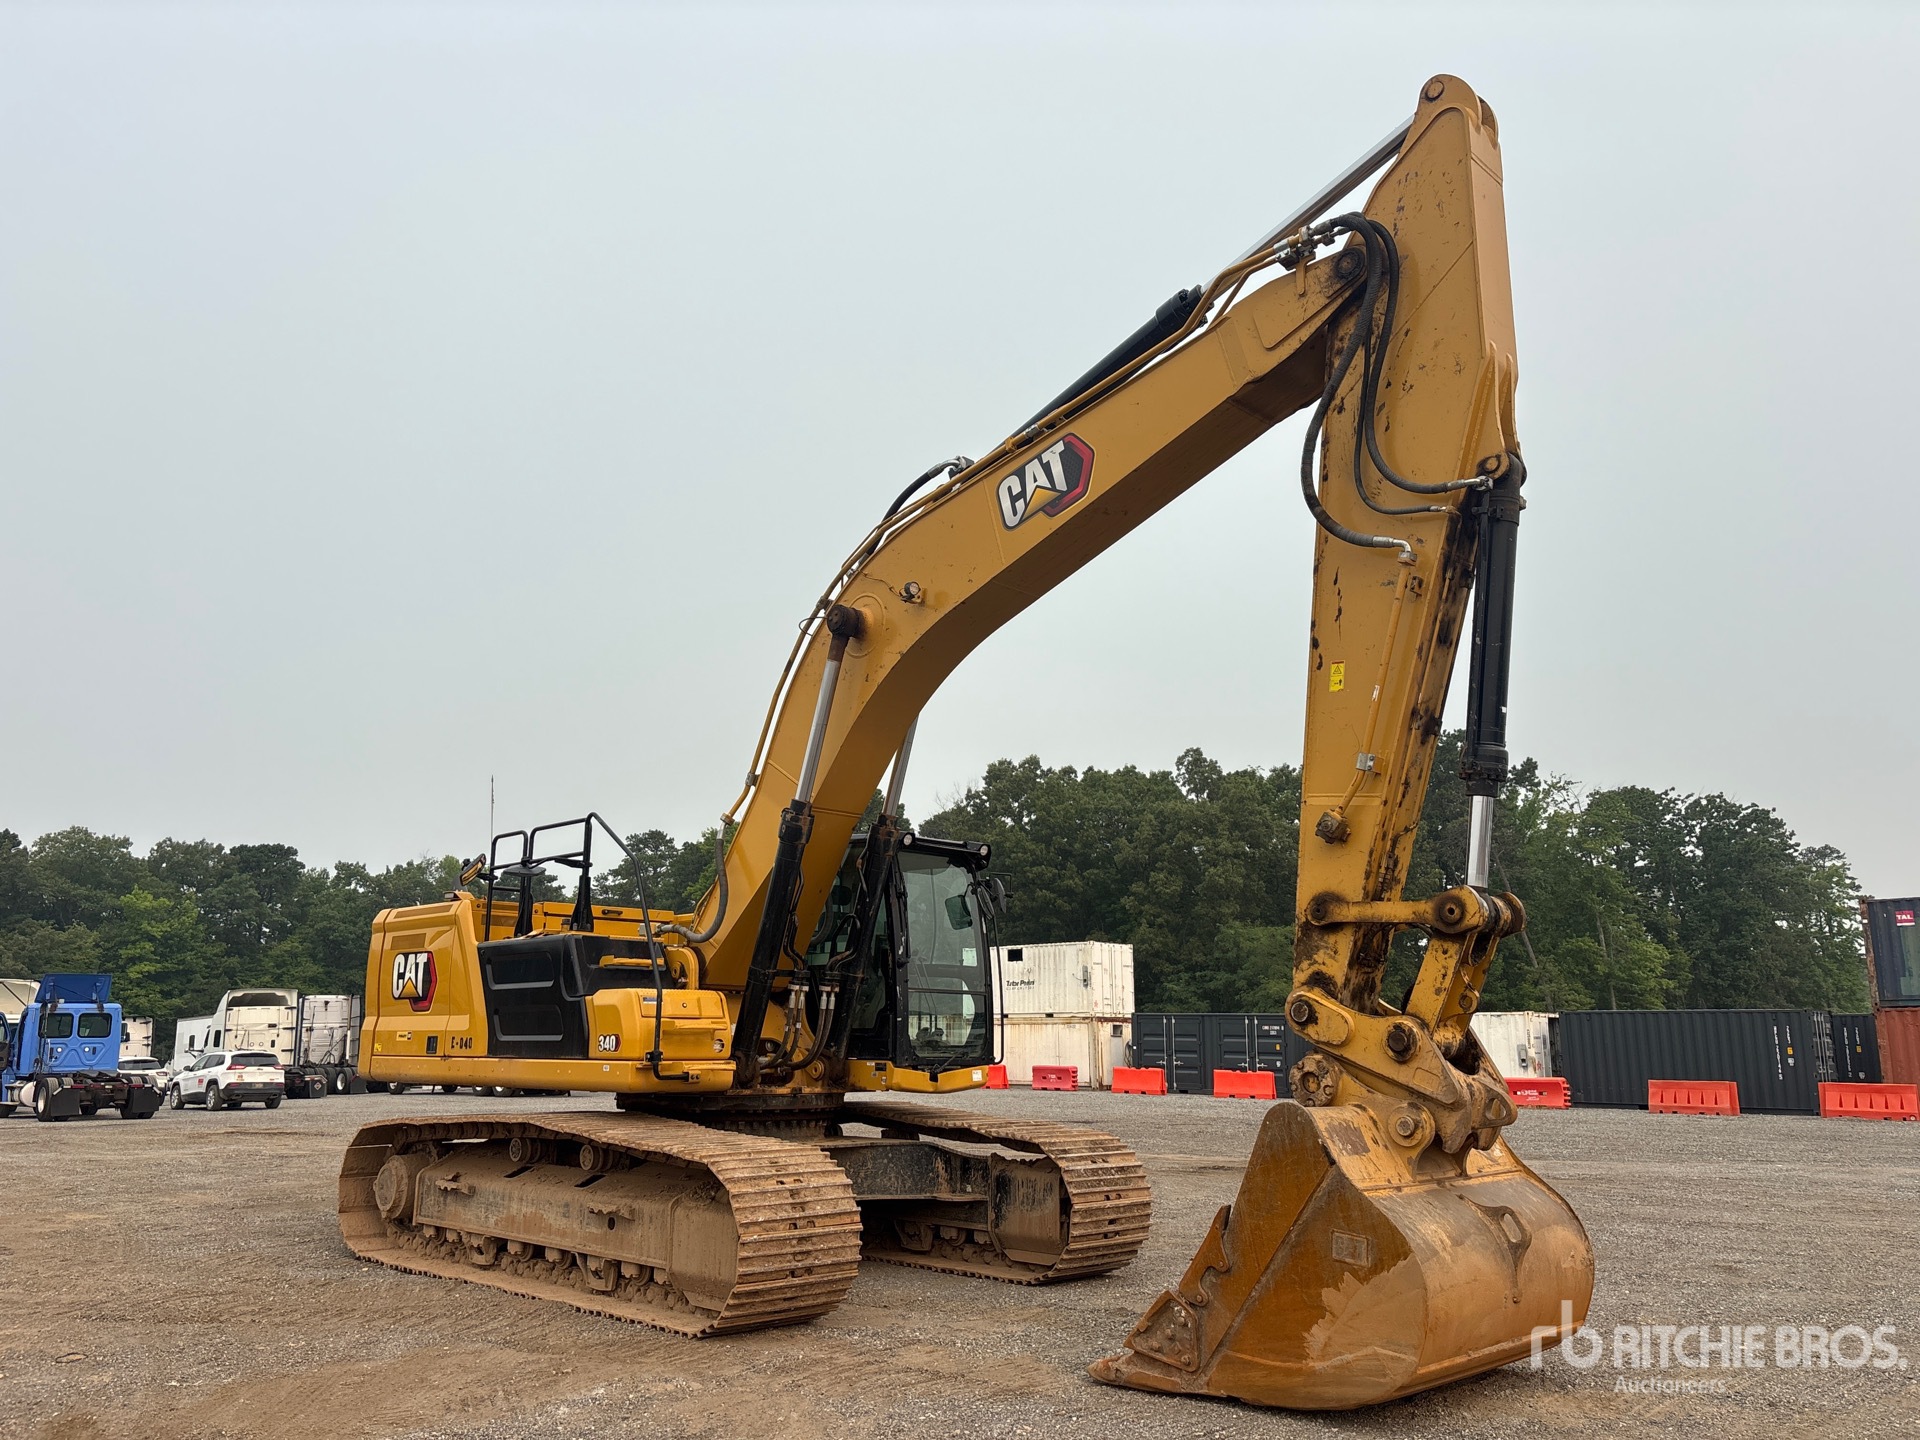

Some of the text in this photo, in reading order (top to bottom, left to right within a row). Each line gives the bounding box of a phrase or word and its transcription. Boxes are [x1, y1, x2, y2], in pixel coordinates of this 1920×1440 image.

[998, 440, 1068, 527] CAT
[392, 952, 428, 999] CAT
[598, 1034, 616, 1052] 340
